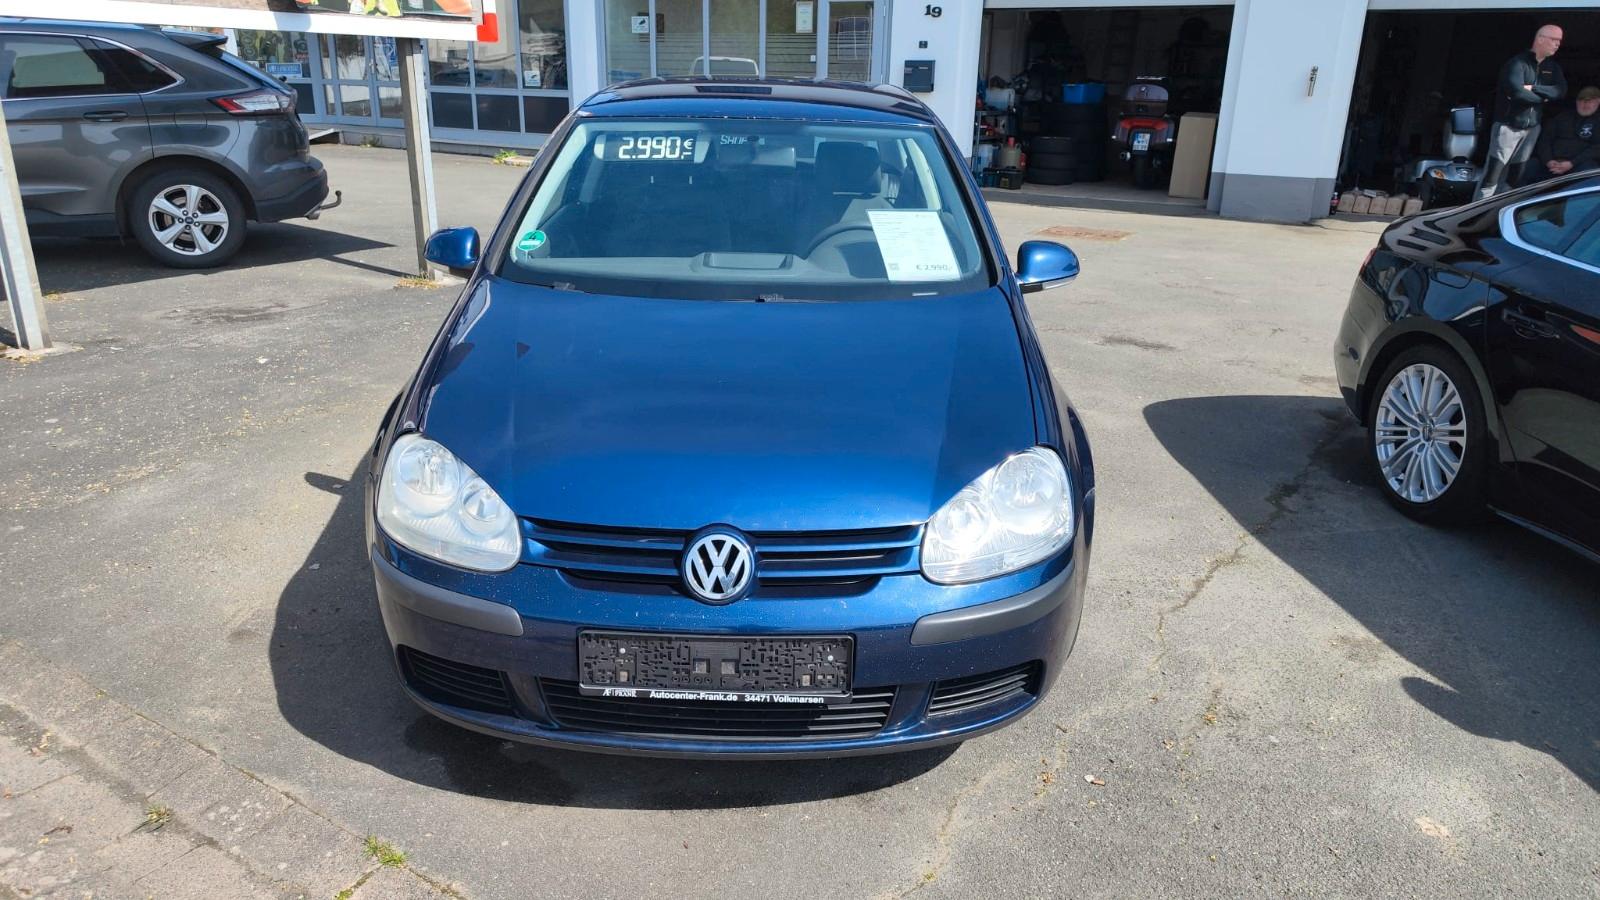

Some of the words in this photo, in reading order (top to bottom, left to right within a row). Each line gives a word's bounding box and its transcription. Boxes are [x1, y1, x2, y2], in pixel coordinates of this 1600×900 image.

[924, 4, 942, 18] 19
[685, 534, 753, 600] VW
[649, 690, 738, 702] Autocenter-Frank.de
[744, 694, 770, 702] 34471
[773, 695, 824, 704] Volkmarsen
